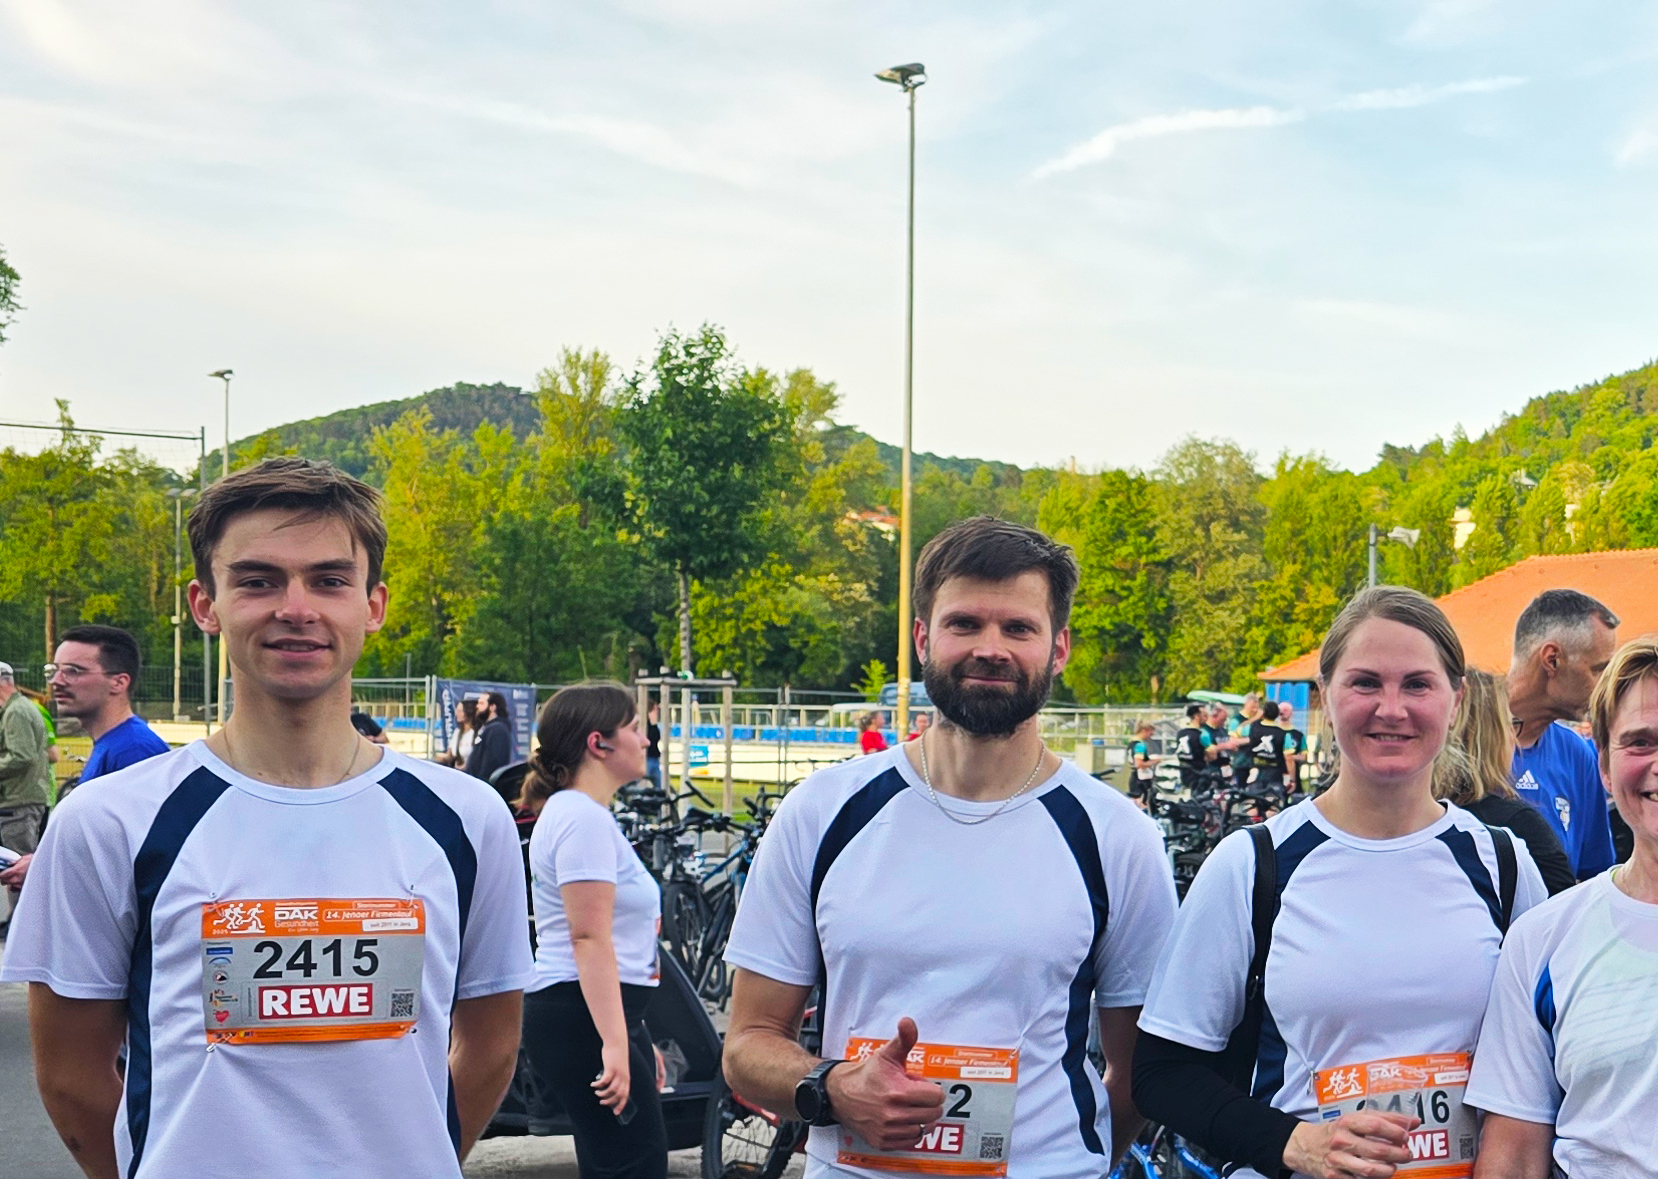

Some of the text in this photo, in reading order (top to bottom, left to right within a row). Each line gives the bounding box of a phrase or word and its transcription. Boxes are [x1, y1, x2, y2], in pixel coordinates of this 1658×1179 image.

[274, 908, 318, 920] DAK
[253, 938, 379, 979] 2415
[262, 986, 370, 1016] REWE
[935, 1082, 972, 1118] 2
[1408, 1132, 1447, 1159] WE
